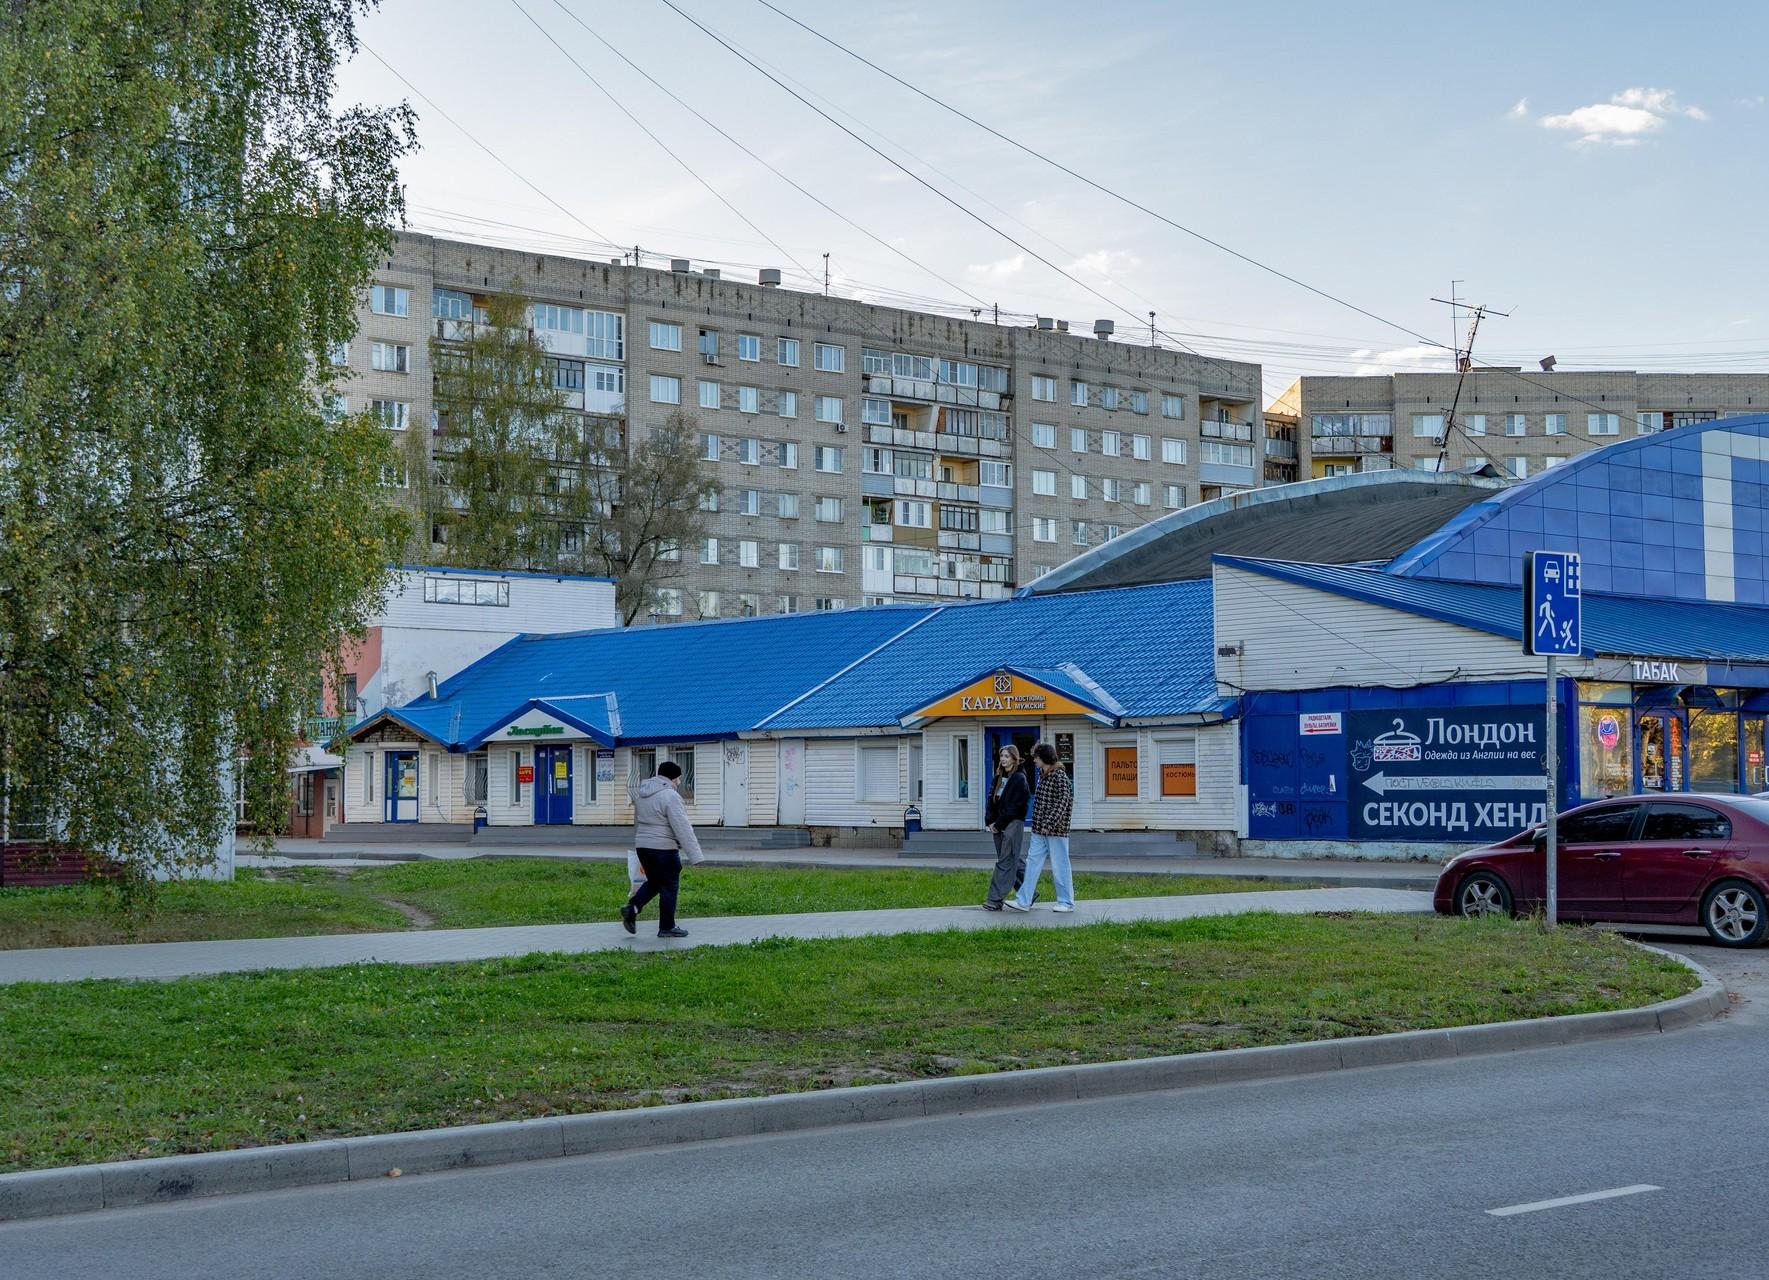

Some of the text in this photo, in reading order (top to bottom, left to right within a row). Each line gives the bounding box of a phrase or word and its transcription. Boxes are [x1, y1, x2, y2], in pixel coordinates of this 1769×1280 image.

[1633, 661, 1680, 681] ТАБАК
[961, 695, 1014, 711] КАРАТ
[1425, 717, 1537, 749] Лондон
[1424, 750, 1458, 760] Одежда
[1471, 750, 1505, 759] Англии
[1507, 751, 1519, 759] на
[1520, 750, 1537, 759] вес
[1362, 802, 1469, 832] СЕКОНД
[1473, 802, 1547, 830] ХЕНД
